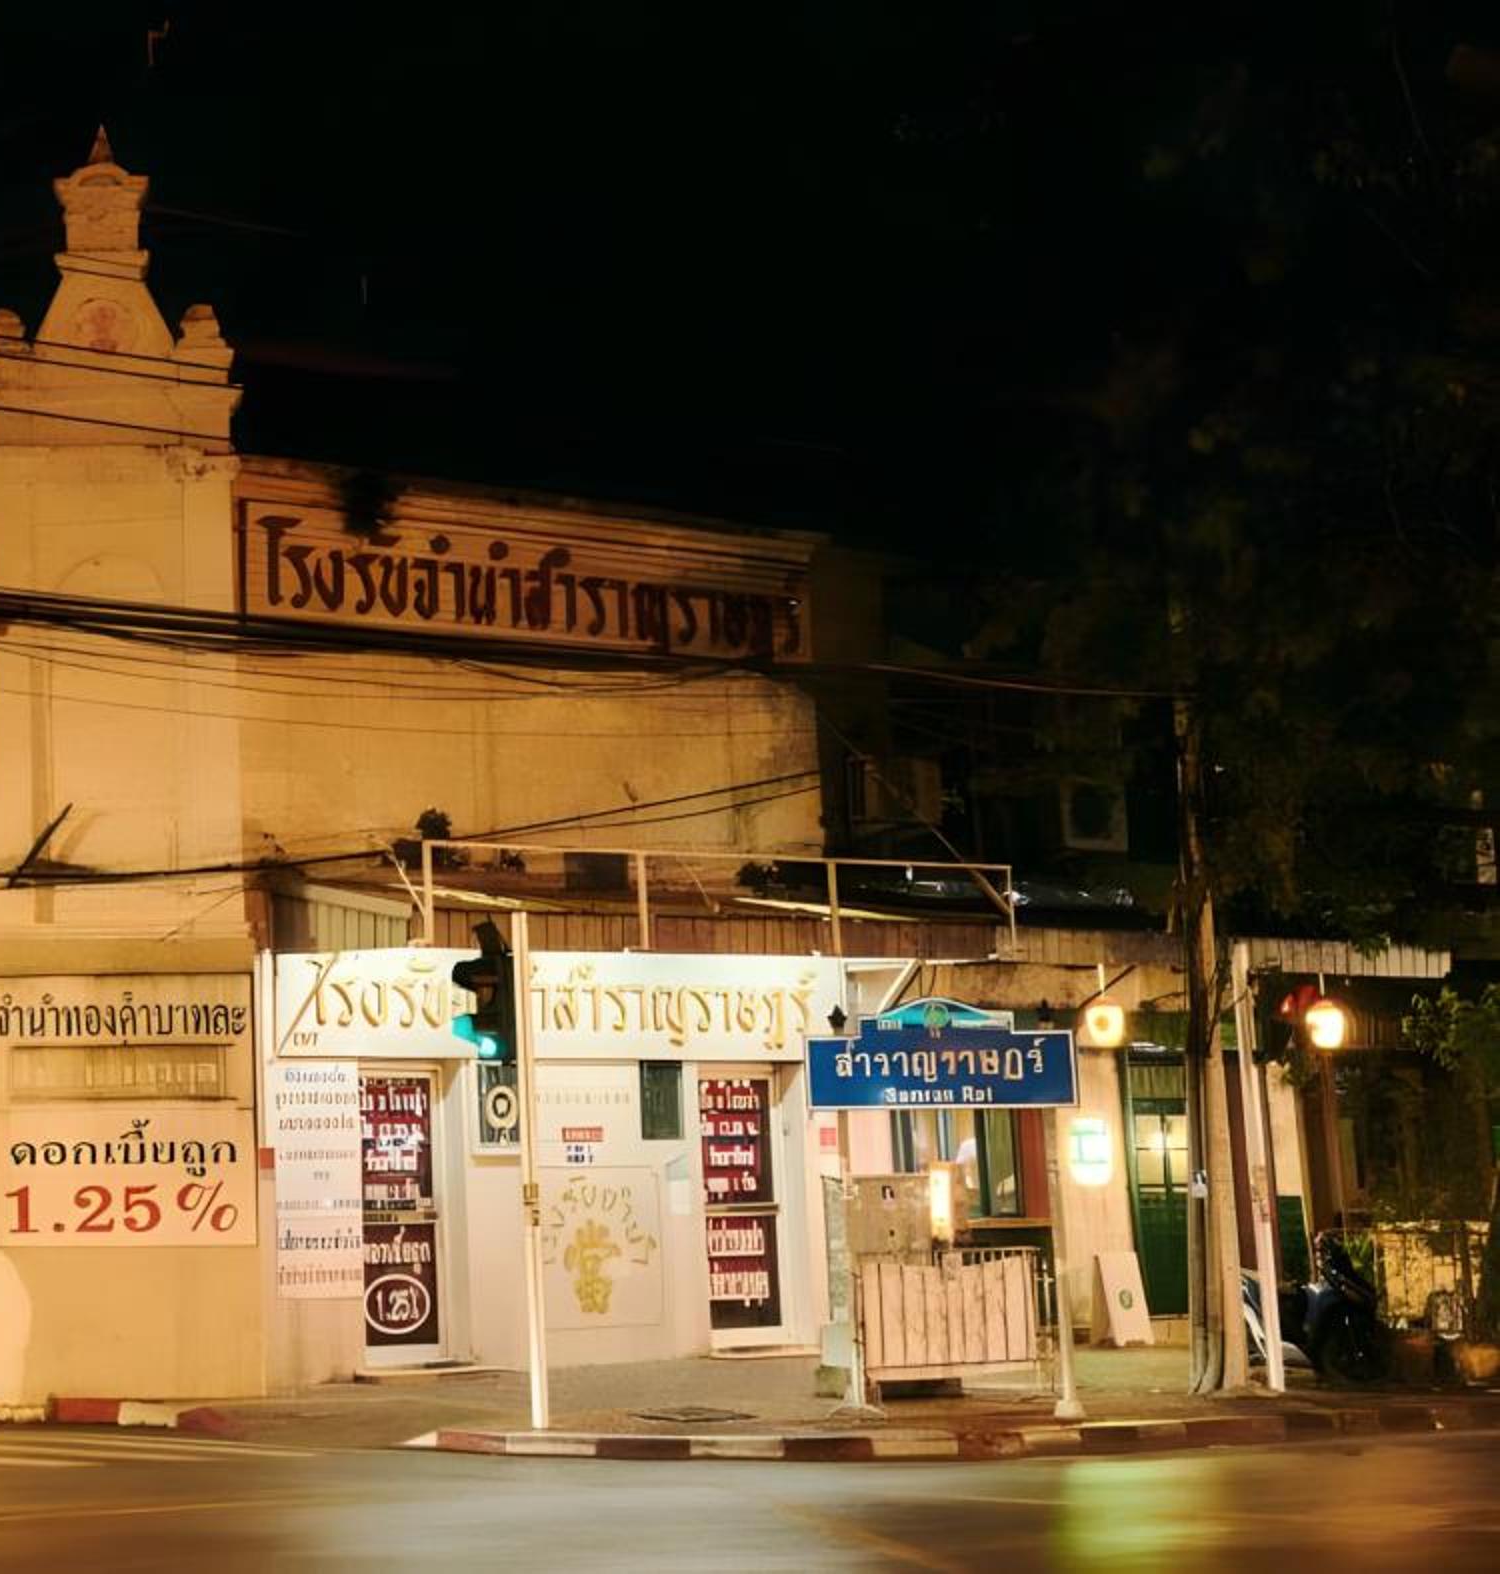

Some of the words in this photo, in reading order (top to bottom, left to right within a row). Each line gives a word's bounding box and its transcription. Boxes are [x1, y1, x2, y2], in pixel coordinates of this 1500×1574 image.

[10, 1119, 237, 1177] ดอกเบี้ยถูก
[5, 1180, 239, 1234] 1.25%
